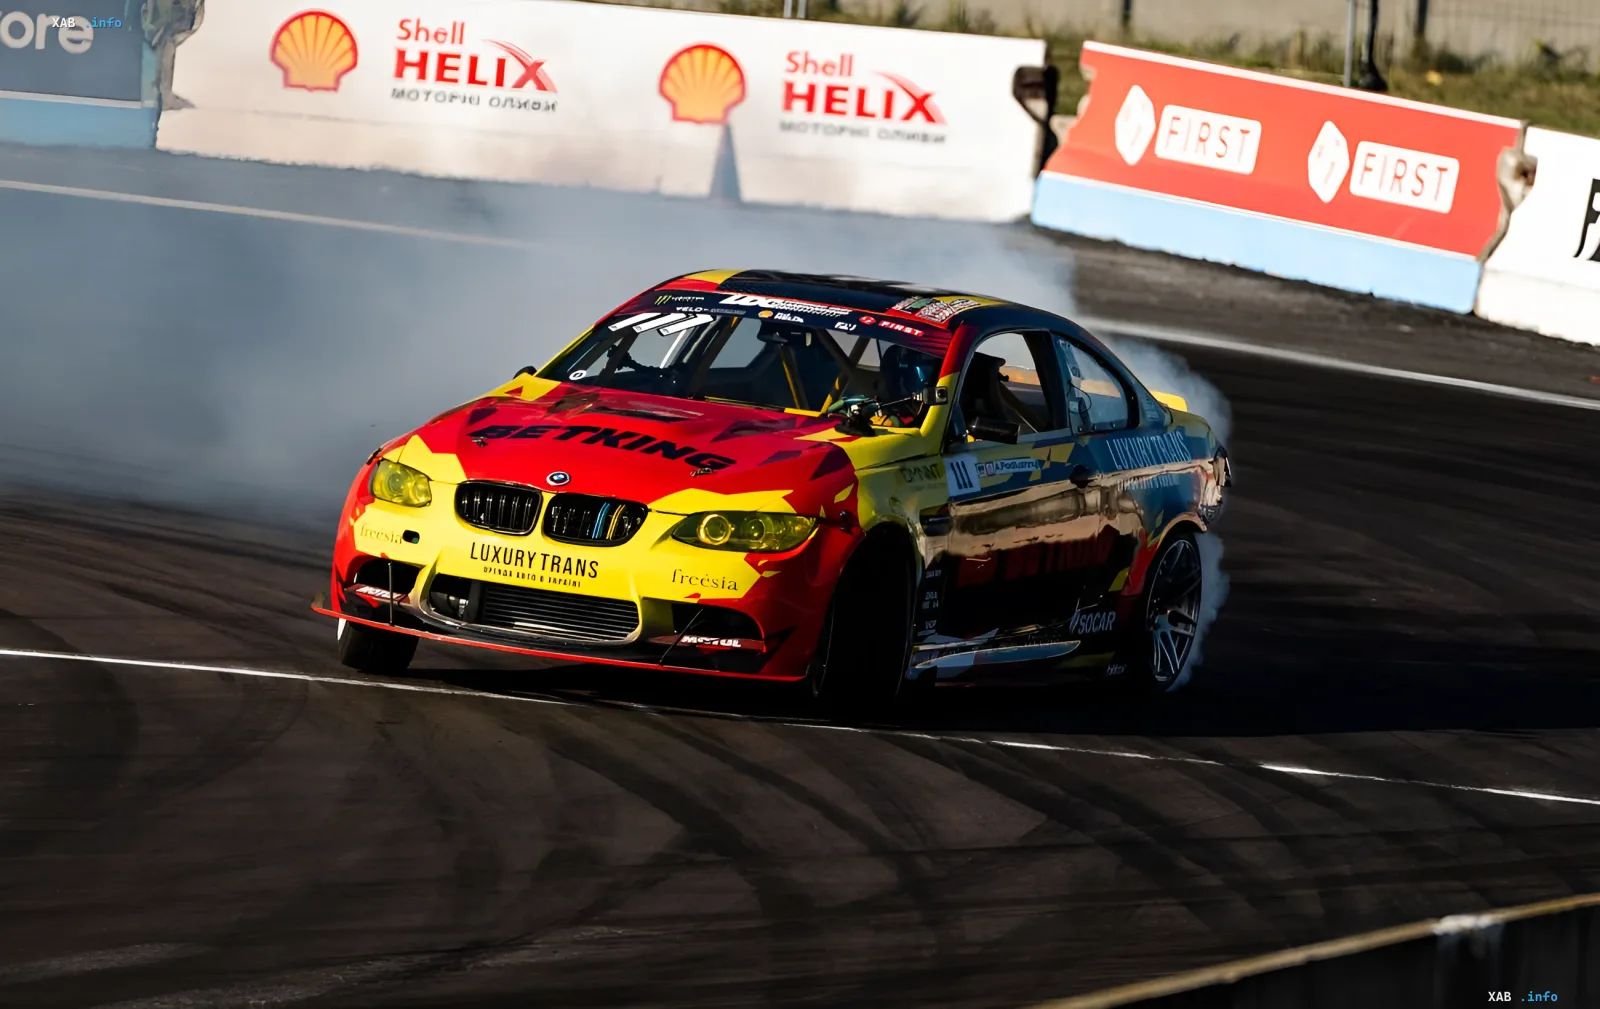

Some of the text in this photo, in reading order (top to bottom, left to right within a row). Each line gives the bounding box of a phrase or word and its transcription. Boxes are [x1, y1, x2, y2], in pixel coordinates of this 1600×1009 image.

[0, 11, 94, 54] ore
[397, 17, 465, 45] Shell
[394, 46, 557, 94] HELIX
[785, 50, 853, 77] Shell
[782, 80, 947, 124] HELIX
[1164, 116, 1251, 163] FIRST
[1359, 152, 1449, 202] FIRST
[881, 321, 923, 336] FIRST
[467, 425, 737, 471] BETKING
[1106, 436, 1157, 470] LUXURY
[470, 541, 599, 579] LUXURY TRANS
[680, 634, 741, 648] MOTUL
[1078, 610, 1117, 635] SOCAR
